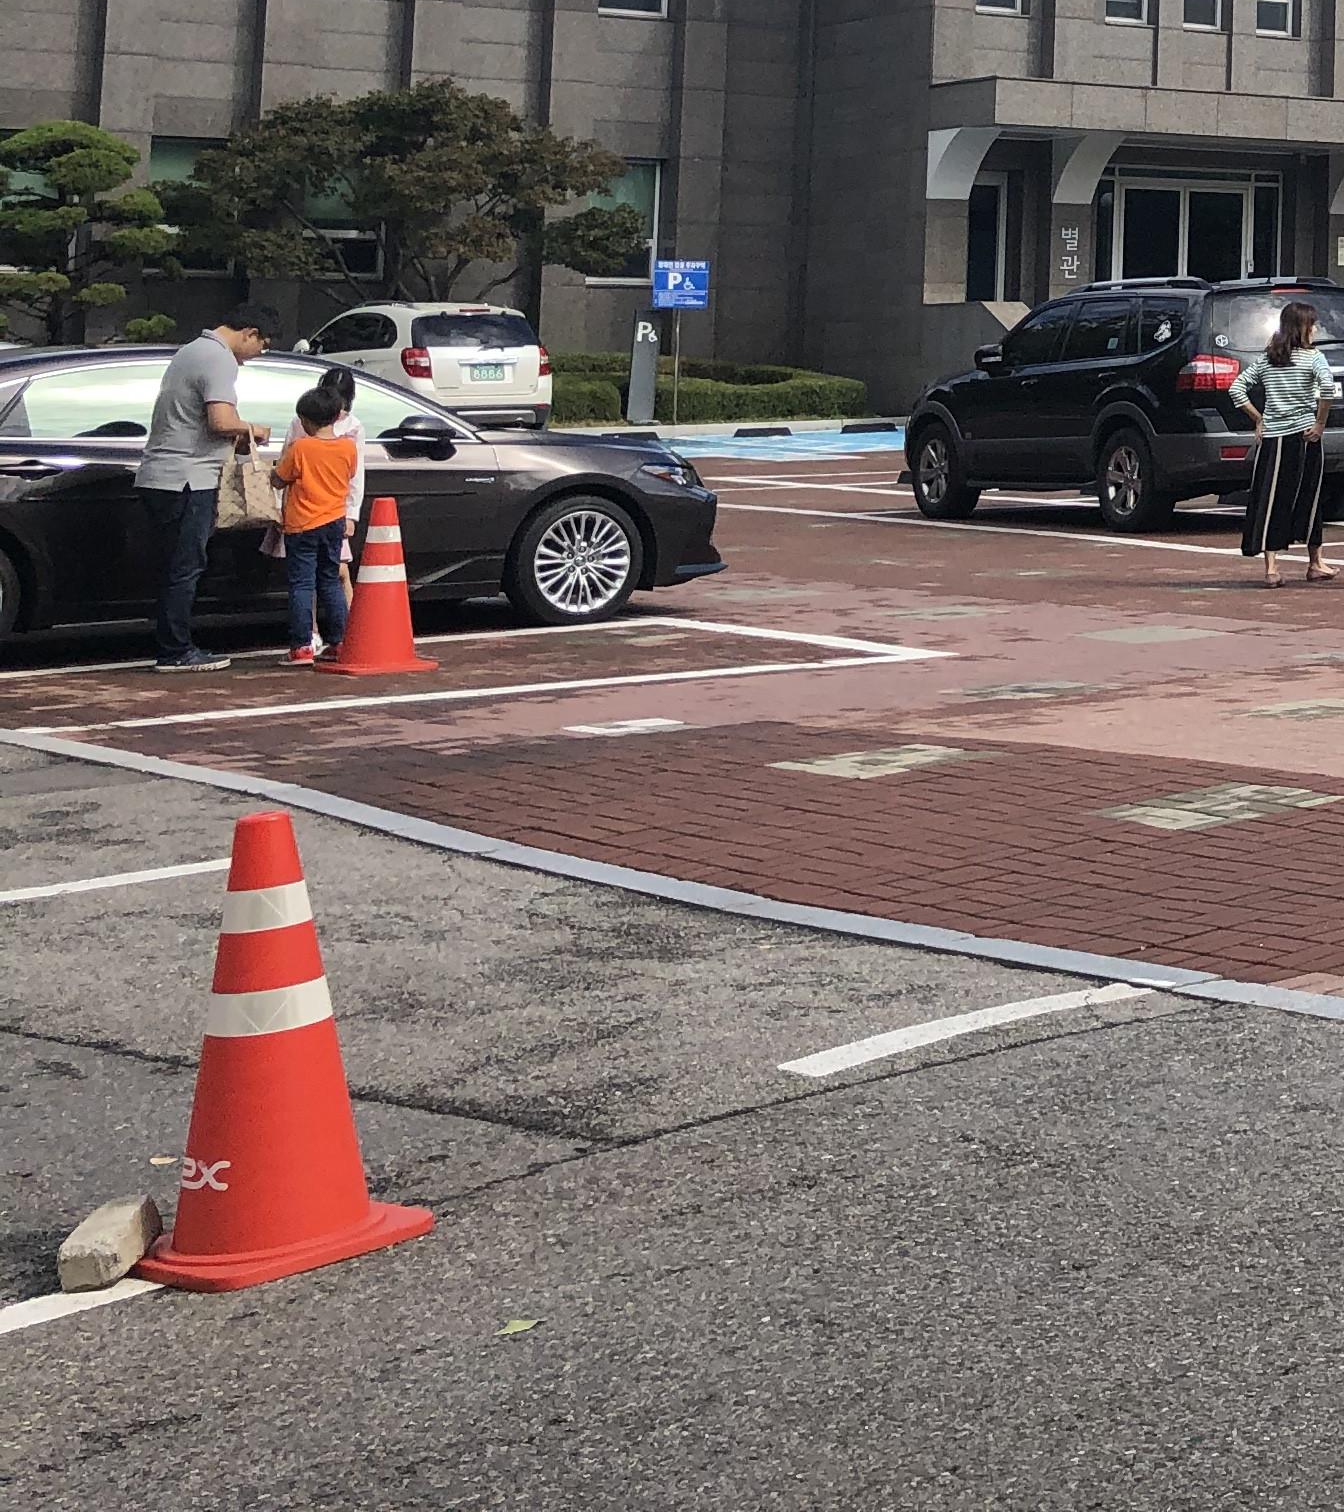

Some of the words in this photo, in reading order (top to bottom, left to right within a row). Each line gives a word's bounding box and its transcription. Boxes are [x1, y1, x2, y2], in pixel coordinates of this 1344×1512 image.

[1060, 227, 1080, 278] 별관
[668, 273, 683, 289] P
[636, 321, 653, 342] P
